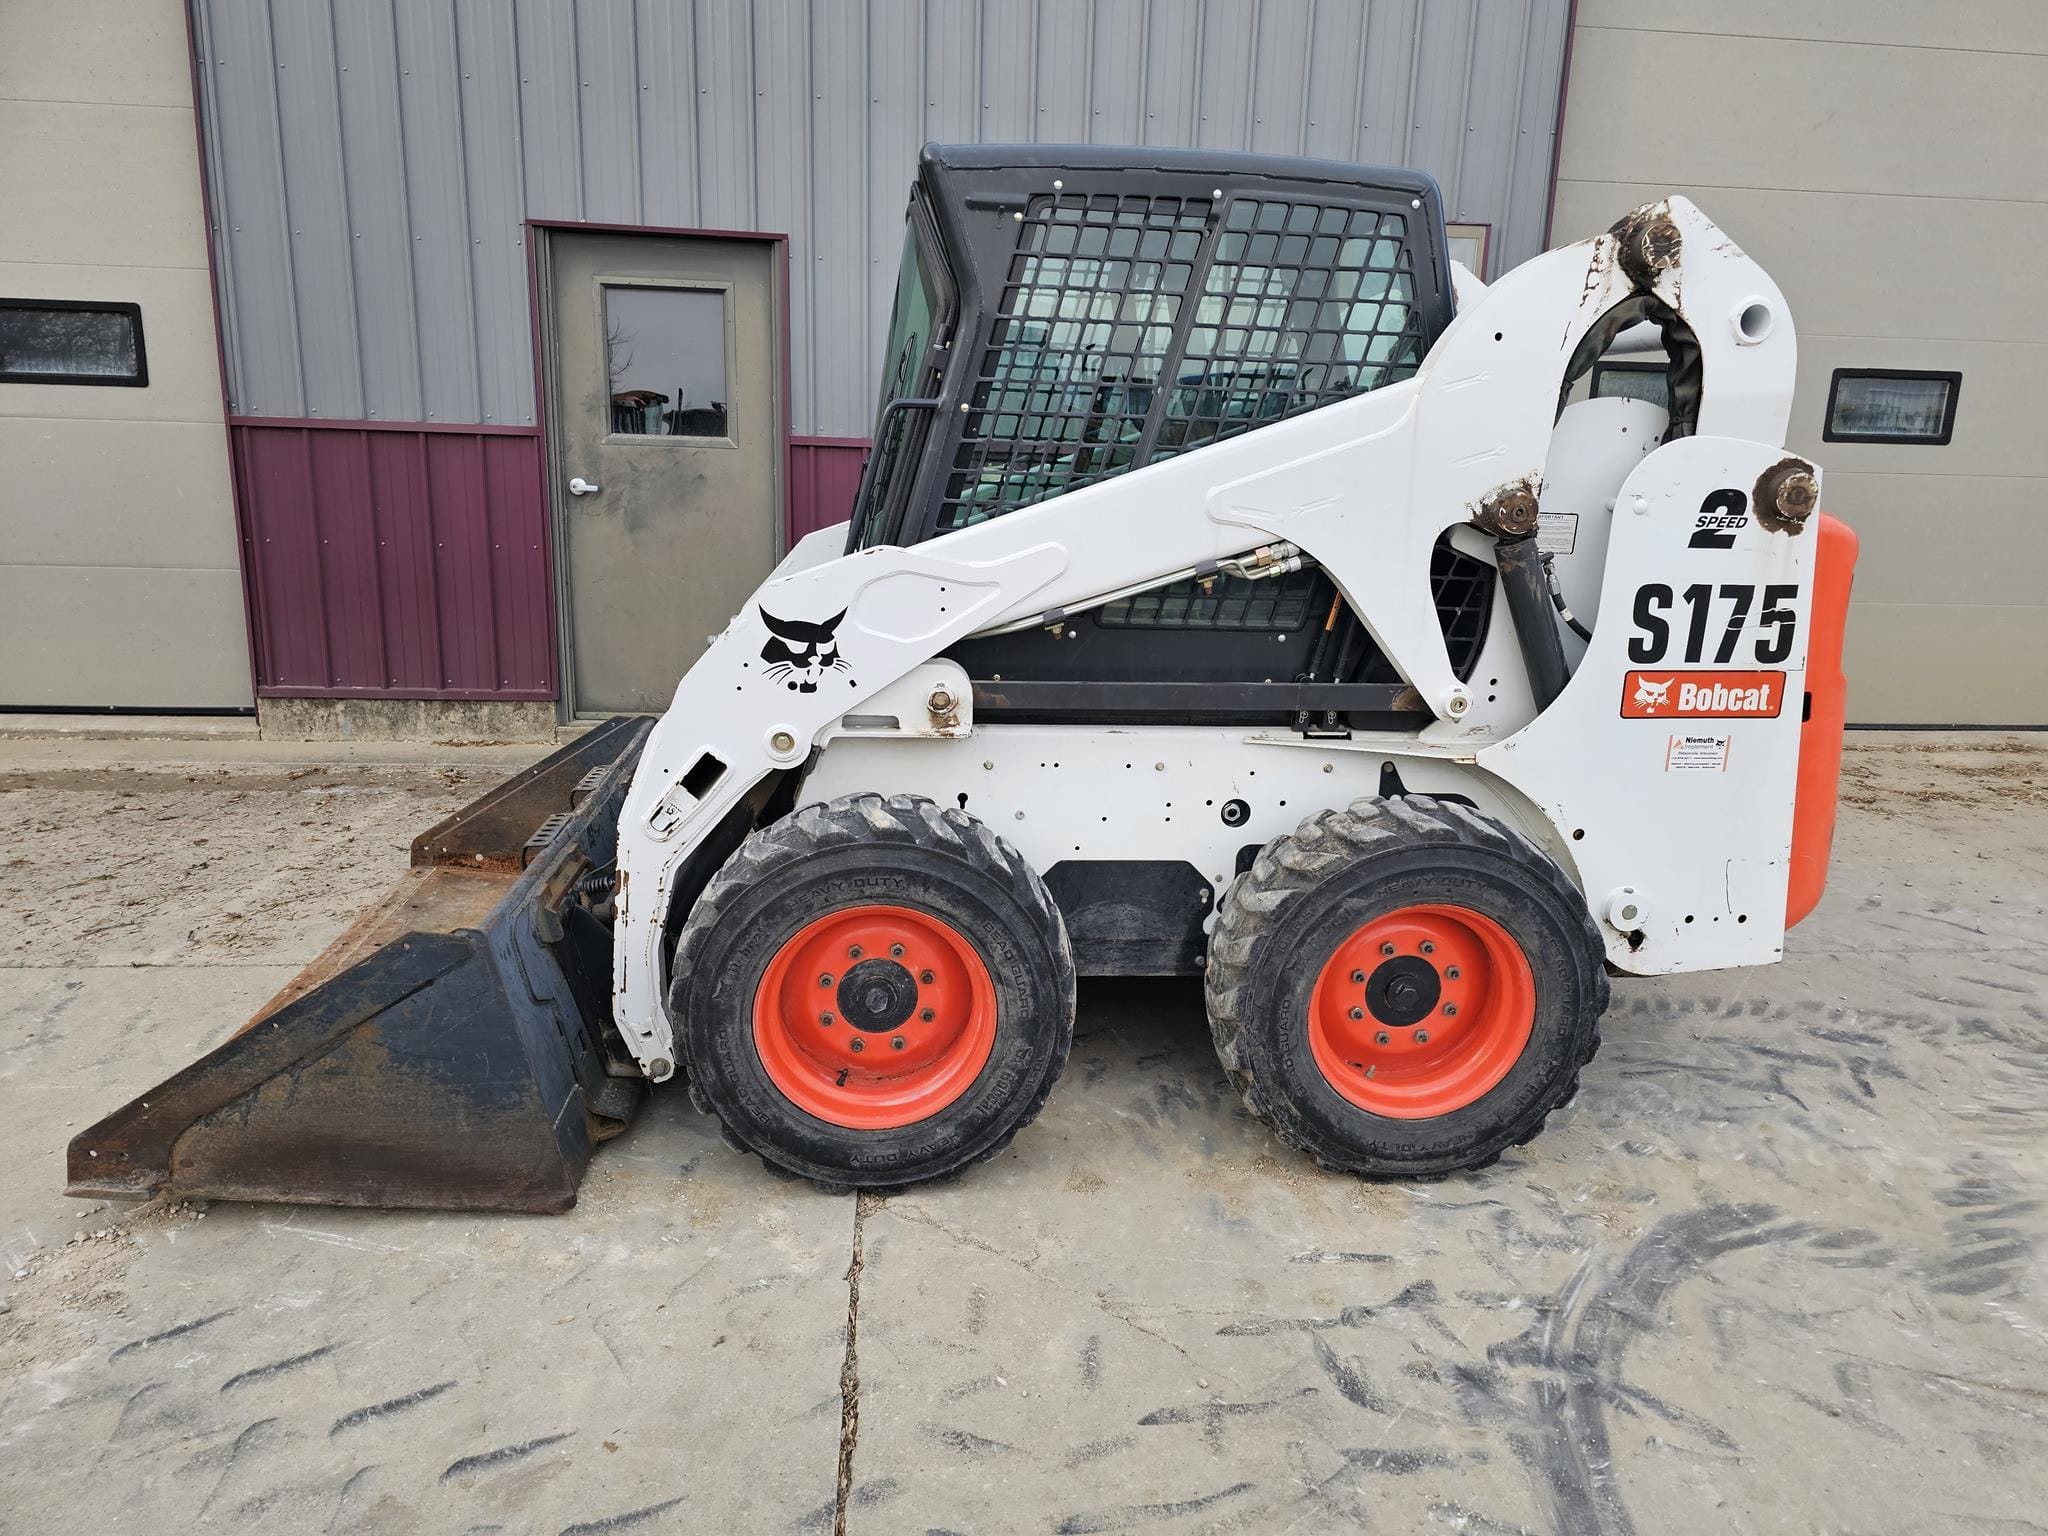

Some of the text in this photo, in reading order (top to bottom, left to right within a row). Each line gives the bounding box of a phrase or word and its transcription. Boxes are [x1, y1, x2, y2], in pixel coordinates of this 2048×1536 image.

[1687, 488, 1748, 549] 2
[1695, 516, 1748, 528] SPEED
[1628, 583, 1799, 664] S175
[853, 877, 904, 889] DUTY
[982, 921, 1015, 961] BEAD
[1011, 965, 1029, 1020] GUARD
[1279, 999, 1291, 1053] GUARD
